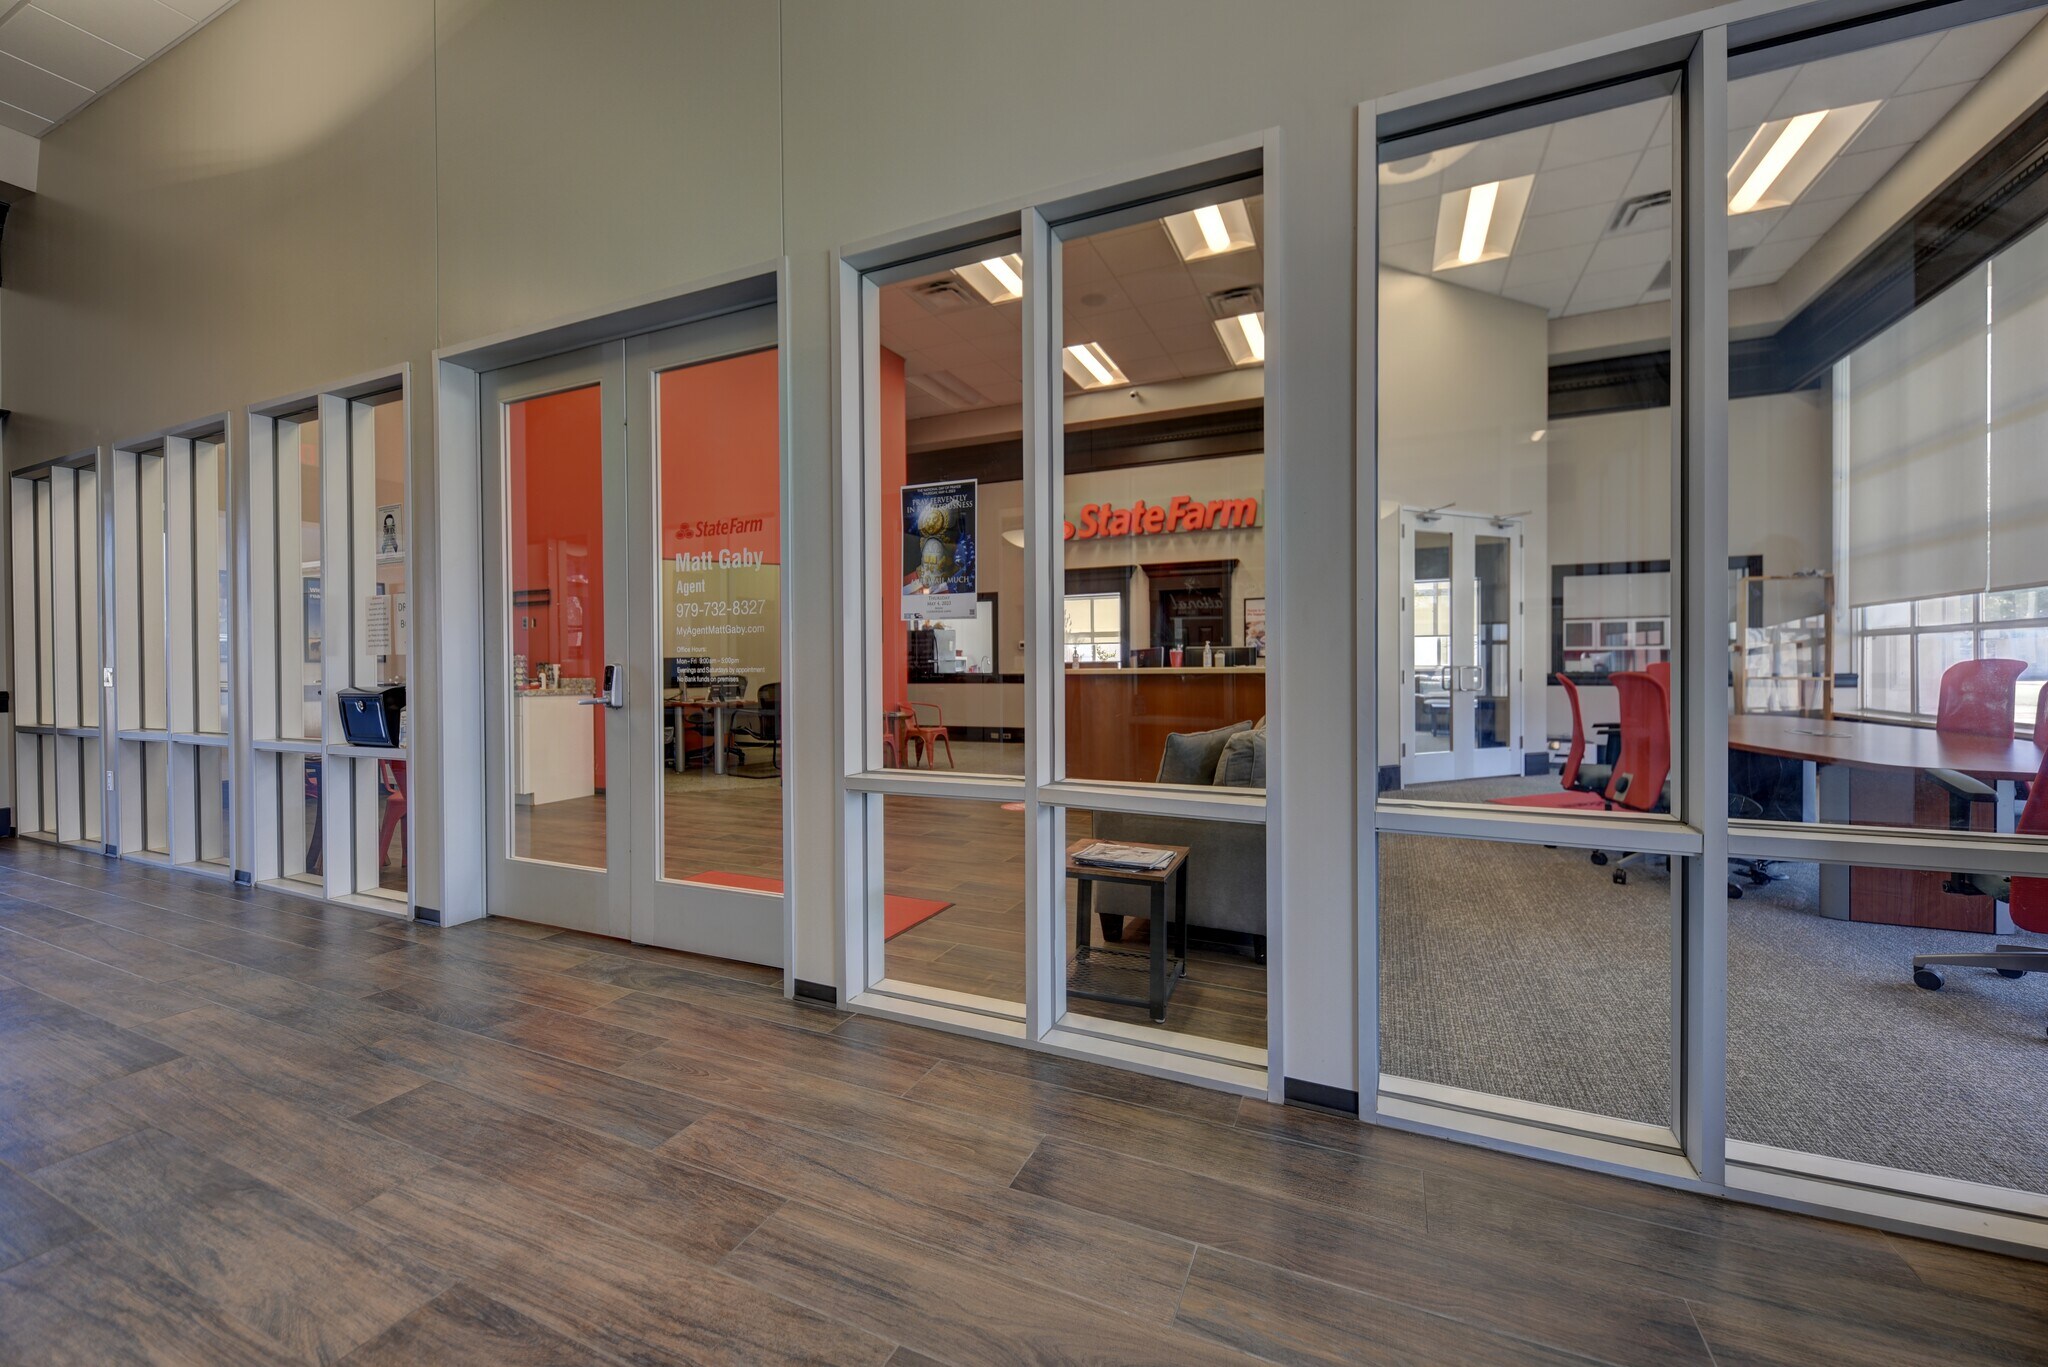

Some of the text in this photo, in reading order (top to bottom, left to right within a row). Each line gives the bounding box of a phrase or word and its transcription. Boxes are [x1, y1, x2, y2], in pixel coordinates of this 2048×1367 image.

[912, 498, 929, 506] PRAY
[906, 506, 915, 514] IN
[675, 547, 764, 573] Matt Gaby
[947, 575, 971, 584] MUCH
[676, 579, 705, 597] Agent
[676, 600, 766, 618] 979-732-8327
[676, 624, 765, 637] MyAgentMattGaby.com
[729, 666, 735, 674] by
[735, 666, 766, 674] appointment
[717, 676, 739, 684] premises
